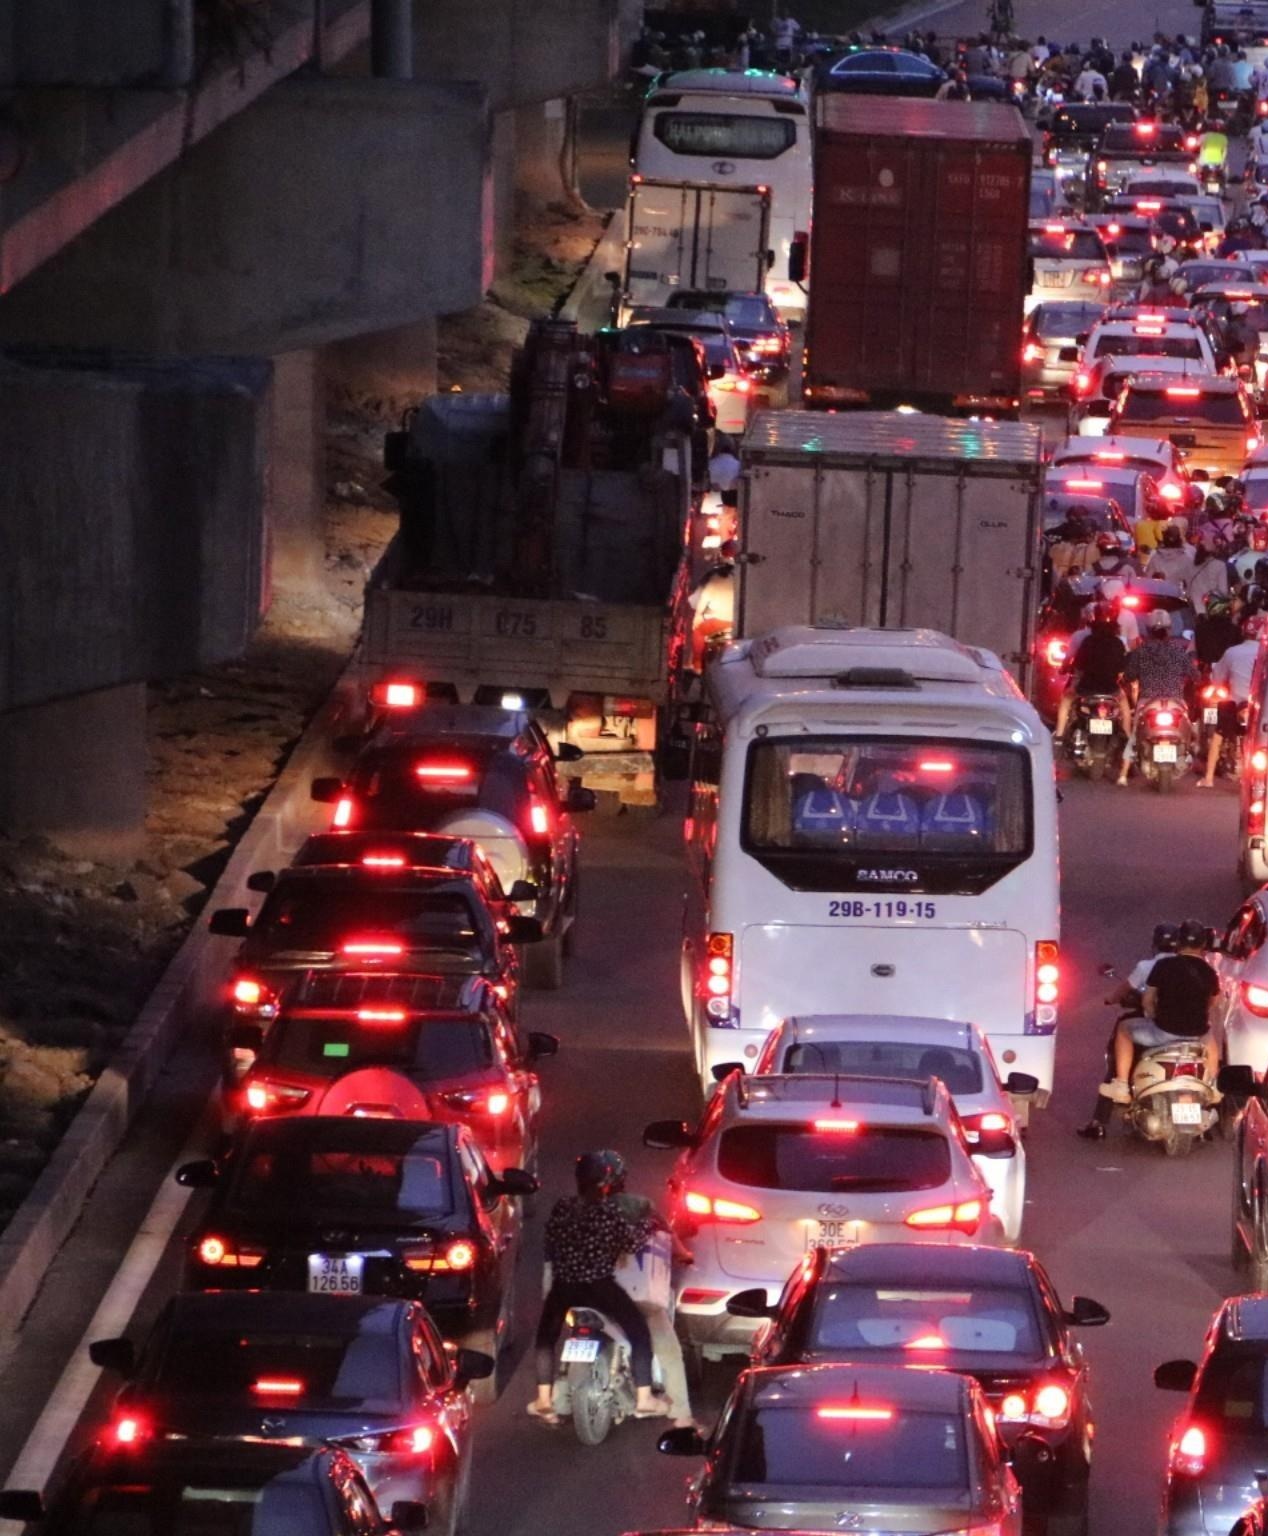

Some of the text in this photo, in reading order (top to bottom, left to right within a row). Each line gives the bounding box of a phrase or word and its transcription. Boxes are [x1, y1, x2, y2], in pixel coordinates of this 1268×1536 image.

[857, 869, 919, 881] SAMCO
[818, 1222, 845, 1238] 30E
[322, 1260, 348, 1275] 34A
